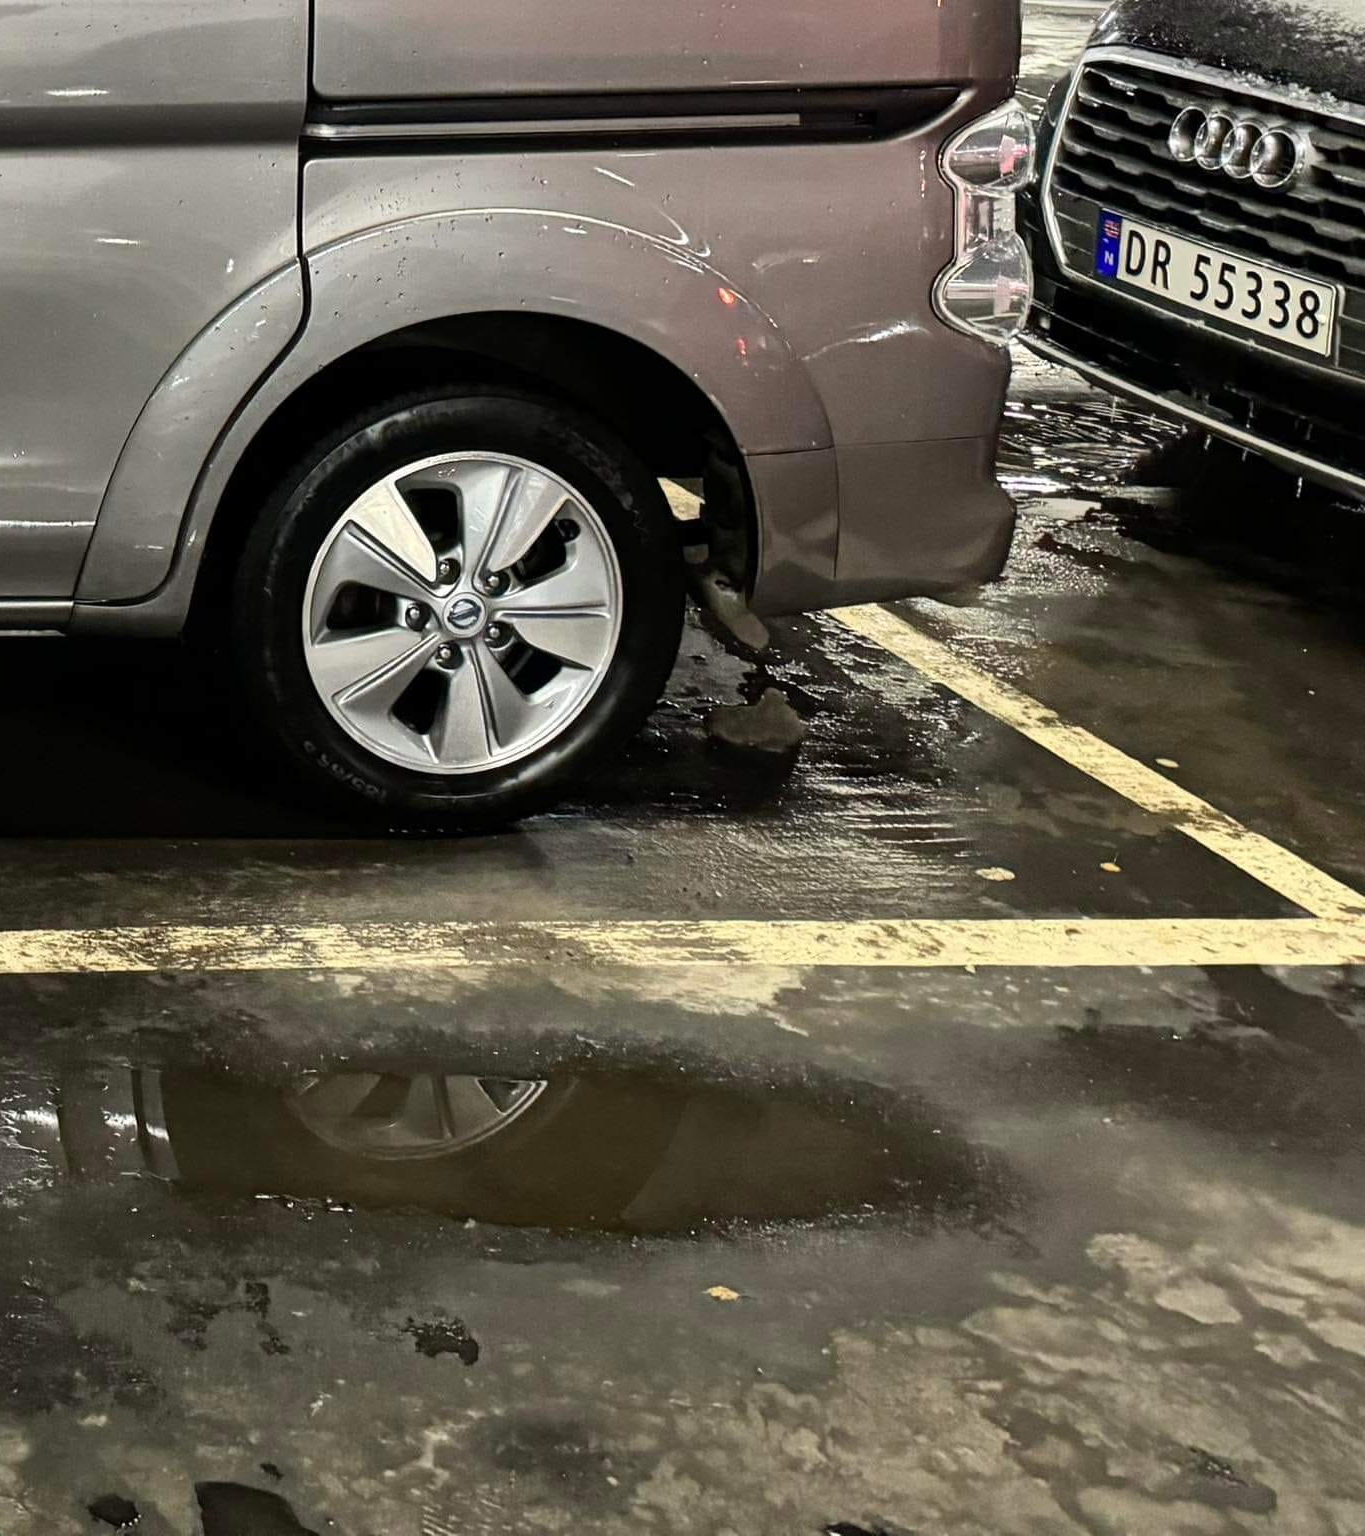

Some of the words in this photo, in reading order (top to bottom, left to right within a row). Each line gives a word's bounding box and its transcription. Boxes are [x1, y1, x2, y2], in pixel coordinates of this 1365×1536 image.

[1104, 250, 1114, 266] N
[1125, 229, 1171, 290] DR
[1190, 253, 1320, 339] 55338
